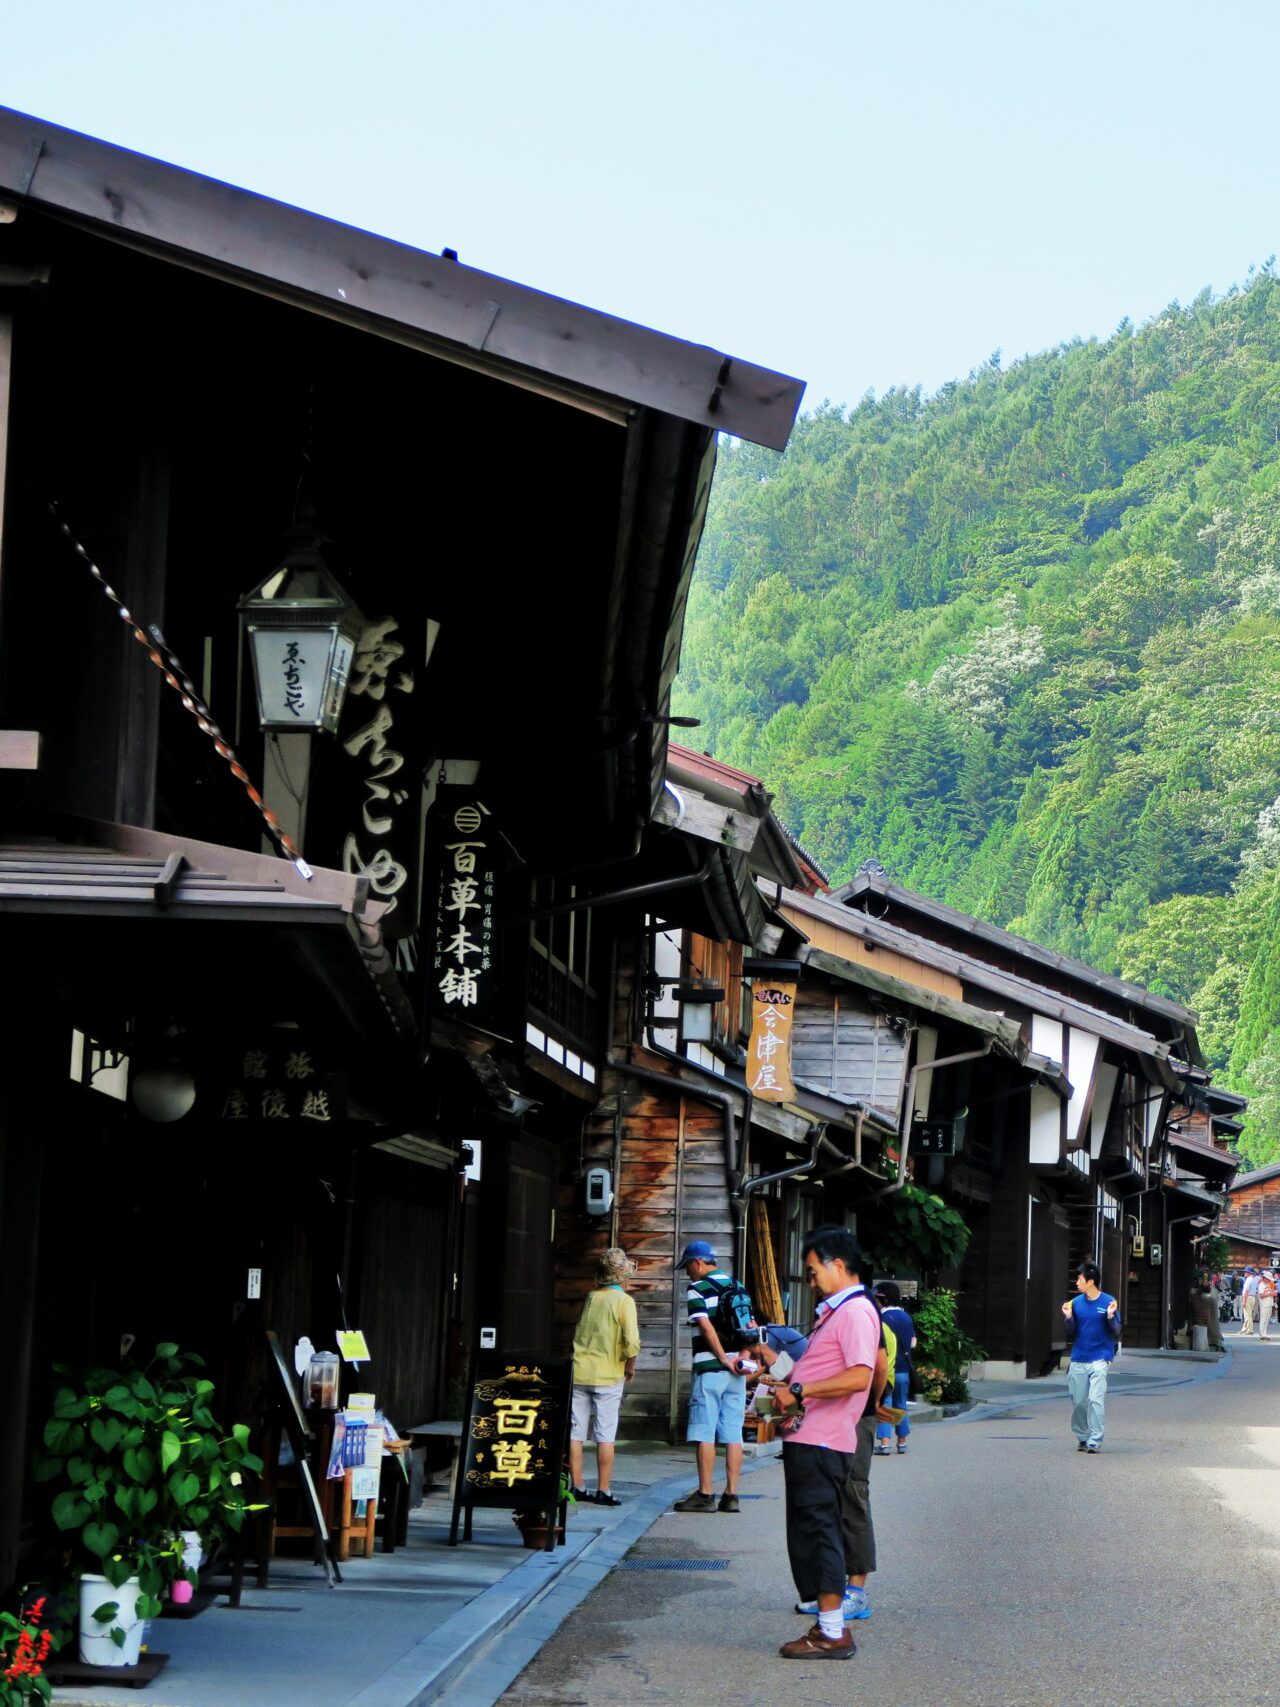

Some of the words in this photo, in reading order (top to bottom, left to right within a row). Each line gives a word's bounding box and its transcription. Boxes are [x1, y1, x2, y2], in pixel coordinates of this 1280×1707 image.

[439, 841, 488, 1008] 百草本舗
[751, 1004, 788, 1092] 会津屋
[490, 1397, 541, 1487] 百草
